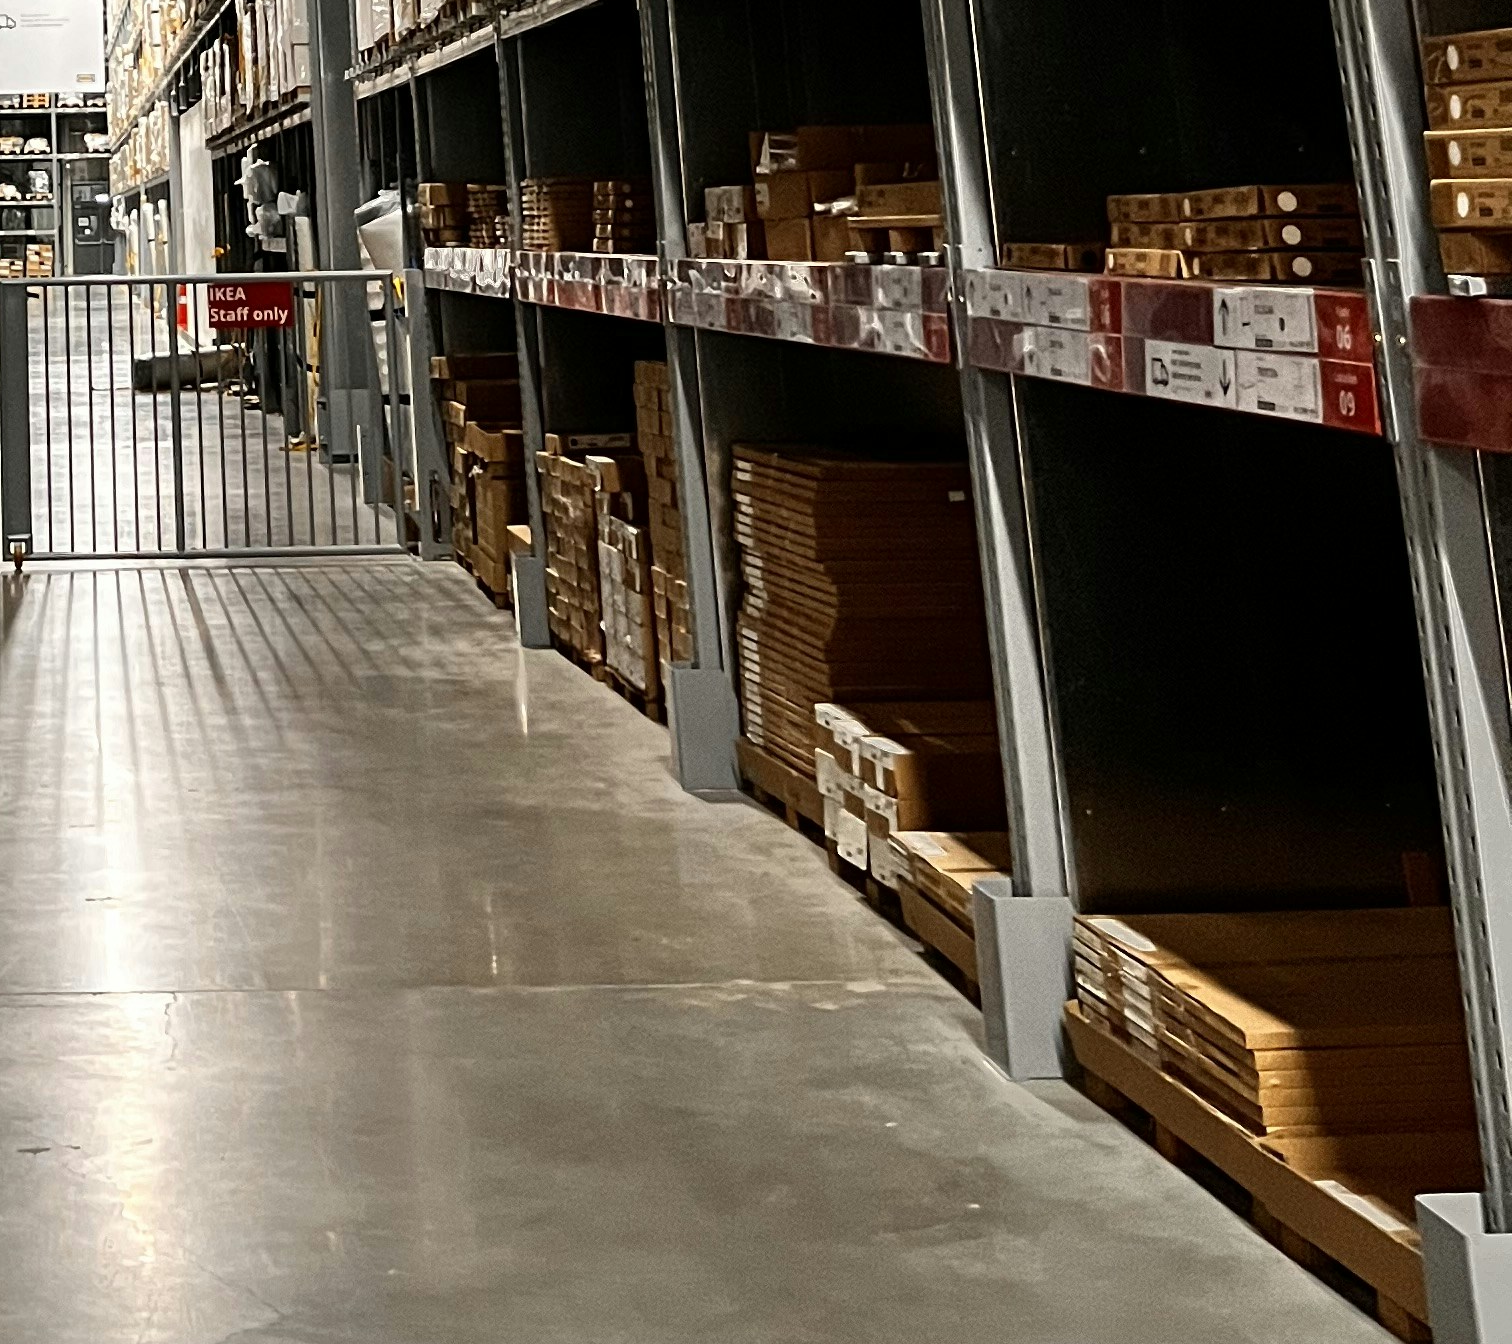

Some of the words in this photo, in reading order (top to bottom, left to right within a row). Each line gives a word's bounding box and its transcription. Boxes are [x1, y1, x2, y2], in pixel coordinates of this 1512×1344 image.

[209, 286, 247, 302] IKEA
[210, 307, 249, 322] Staff
[252, 307, 288, 325] only
[1335, 324, 1352, 351] 06
[1338, 389, 1356, 417] 09
